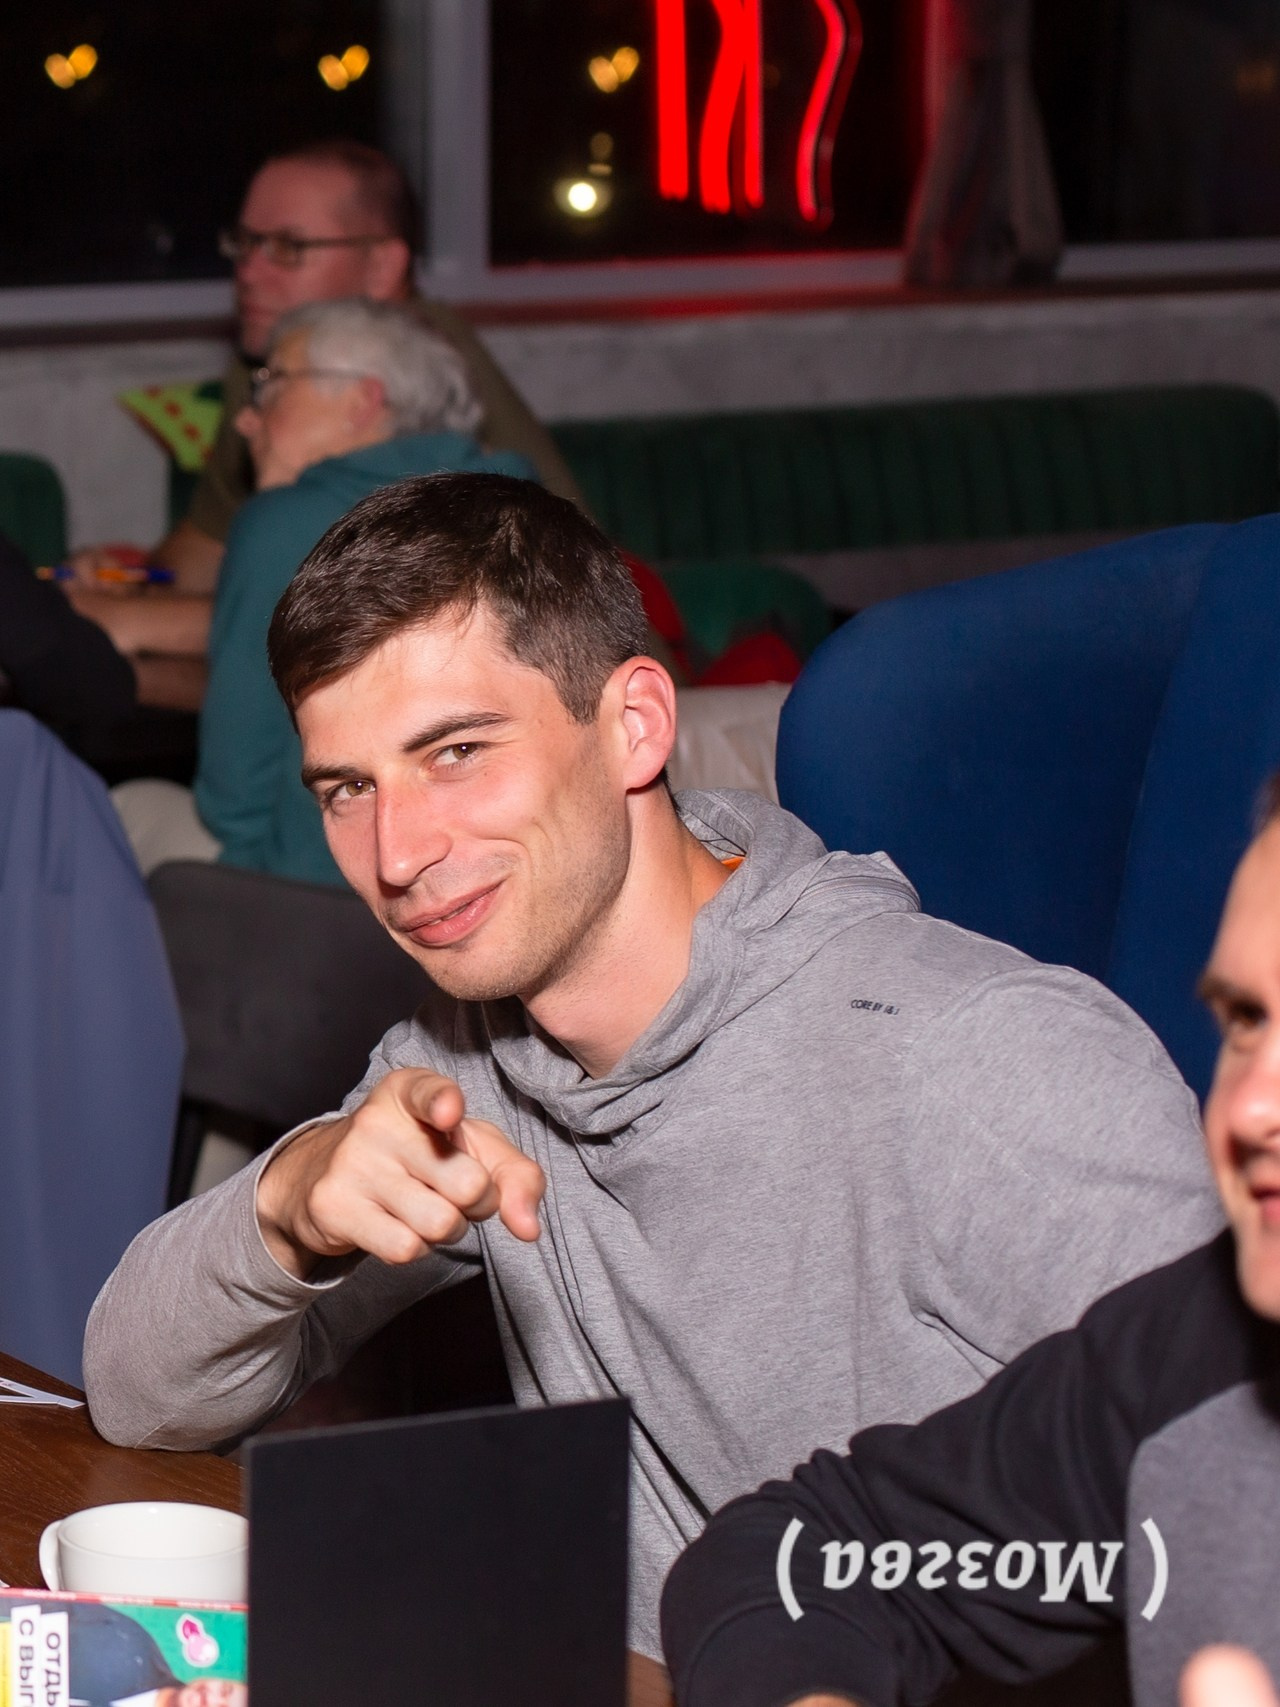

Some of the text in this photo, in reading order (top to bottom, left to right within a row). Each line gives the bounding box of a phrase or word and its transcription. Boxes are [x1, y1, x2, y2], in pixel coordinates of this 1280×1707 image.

[851, 999, 873, 1010] CORE
[872, 1002, 884, 1011] BY
[19, 1619, 35, 1707] С ВЫГ
